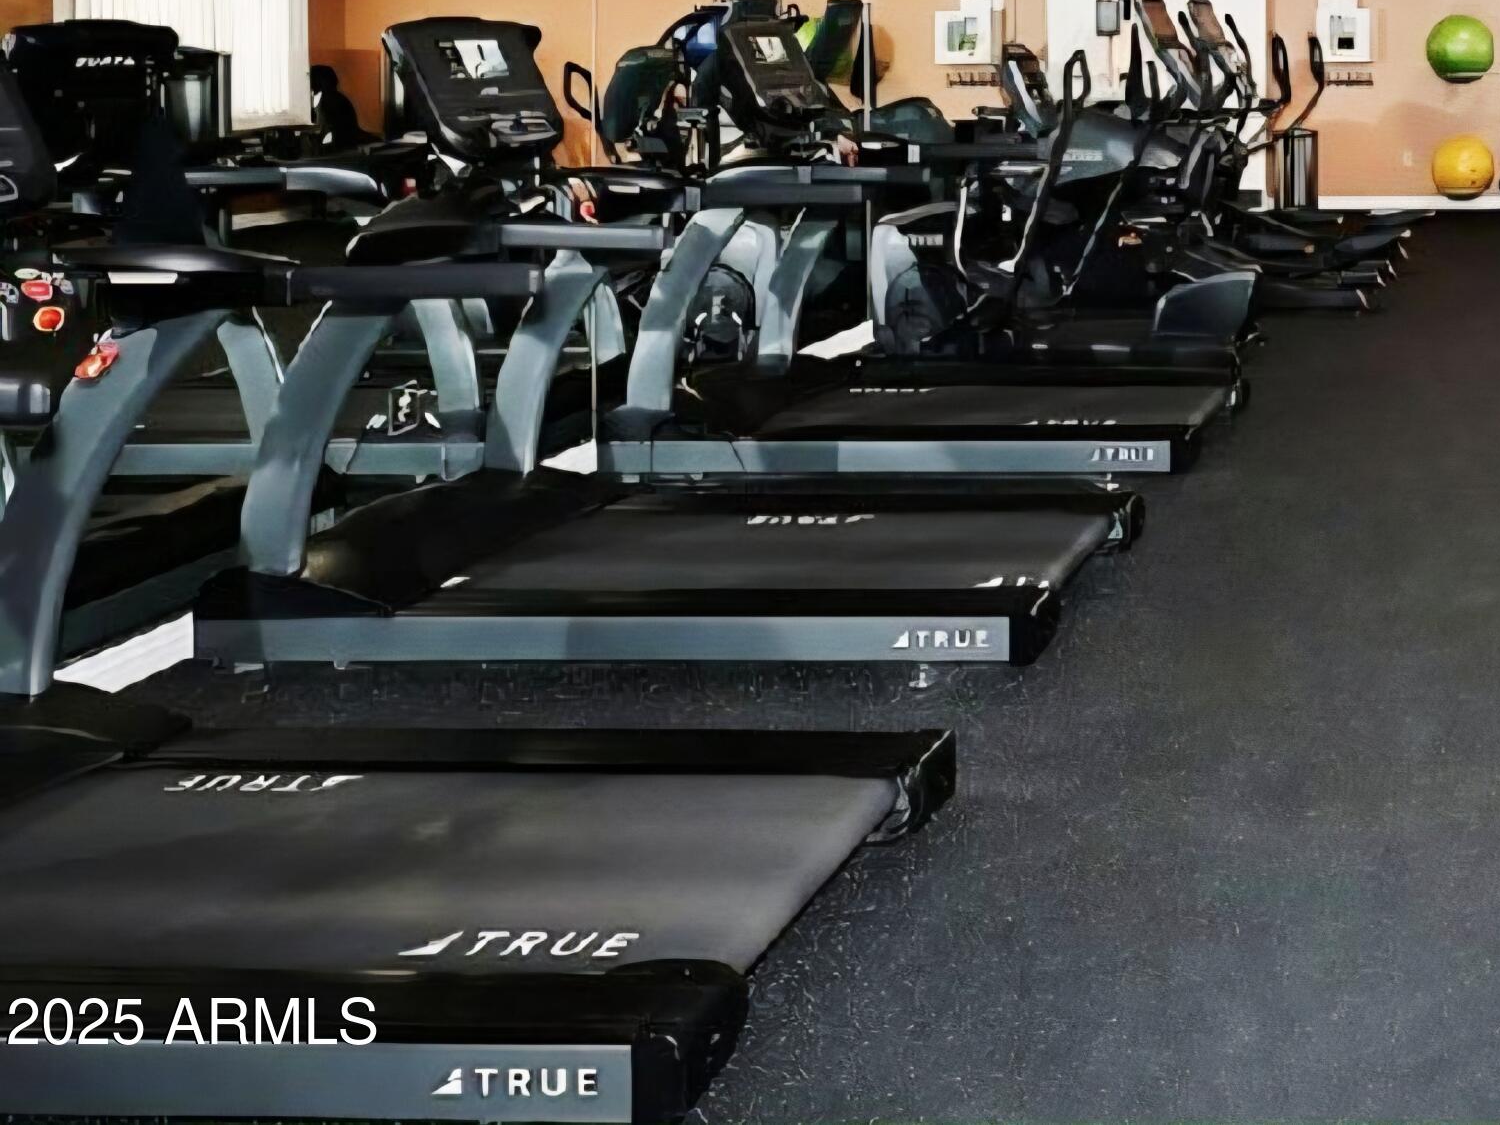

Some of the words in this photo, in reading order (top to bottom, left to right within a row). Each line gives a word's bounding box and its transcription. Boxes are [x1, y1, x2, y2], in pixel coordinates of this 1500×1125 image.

[916, 629, 990, 649] TRUE
[464, 930, 640, 957] TRUE
[474, 1068, 599, 1097] TRUE
